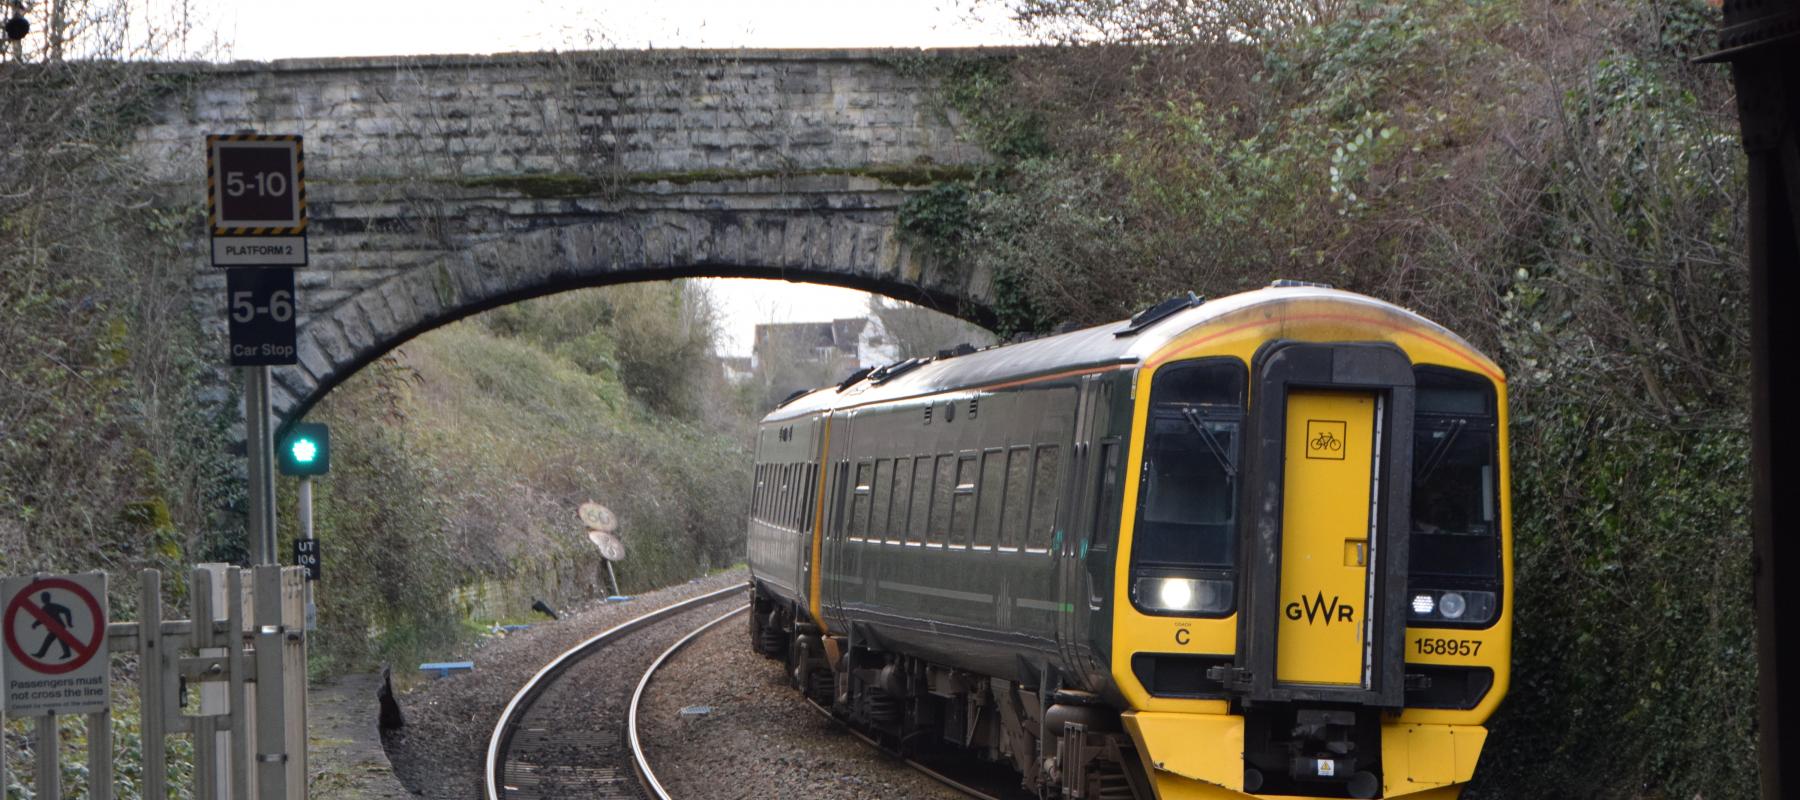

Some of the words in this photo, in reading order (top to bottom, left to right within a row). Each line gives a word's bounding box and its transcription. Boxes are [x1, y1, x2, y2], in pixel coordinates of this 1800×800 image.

[226, 171, 287, 197] 5-10
[225, 245, 284, 256] PLATFORM
[285, 245, 294, 255] 2
[232, 289, 292, 323] 5-6
[233, 343, 258, 357] Car
[261, 343, 294, 358] Stop
[298, 541, 314, 552] UT
[297, 554, 316, 565] 106
[304, 567, 312, 577] R
[1285, 590, 1354, 627] GWR
[1175, 628, 1190, 646] C
[1414, 637, 1483, 657] 158957
[10, 679, 74, 690] Passengers
[75, 675, 103, 685] must
[11, 690, 29, 701] not
[31, 688, 62, 699] cross
[64, 686, 82, 698] the
[84, 686, 104, 697] line
